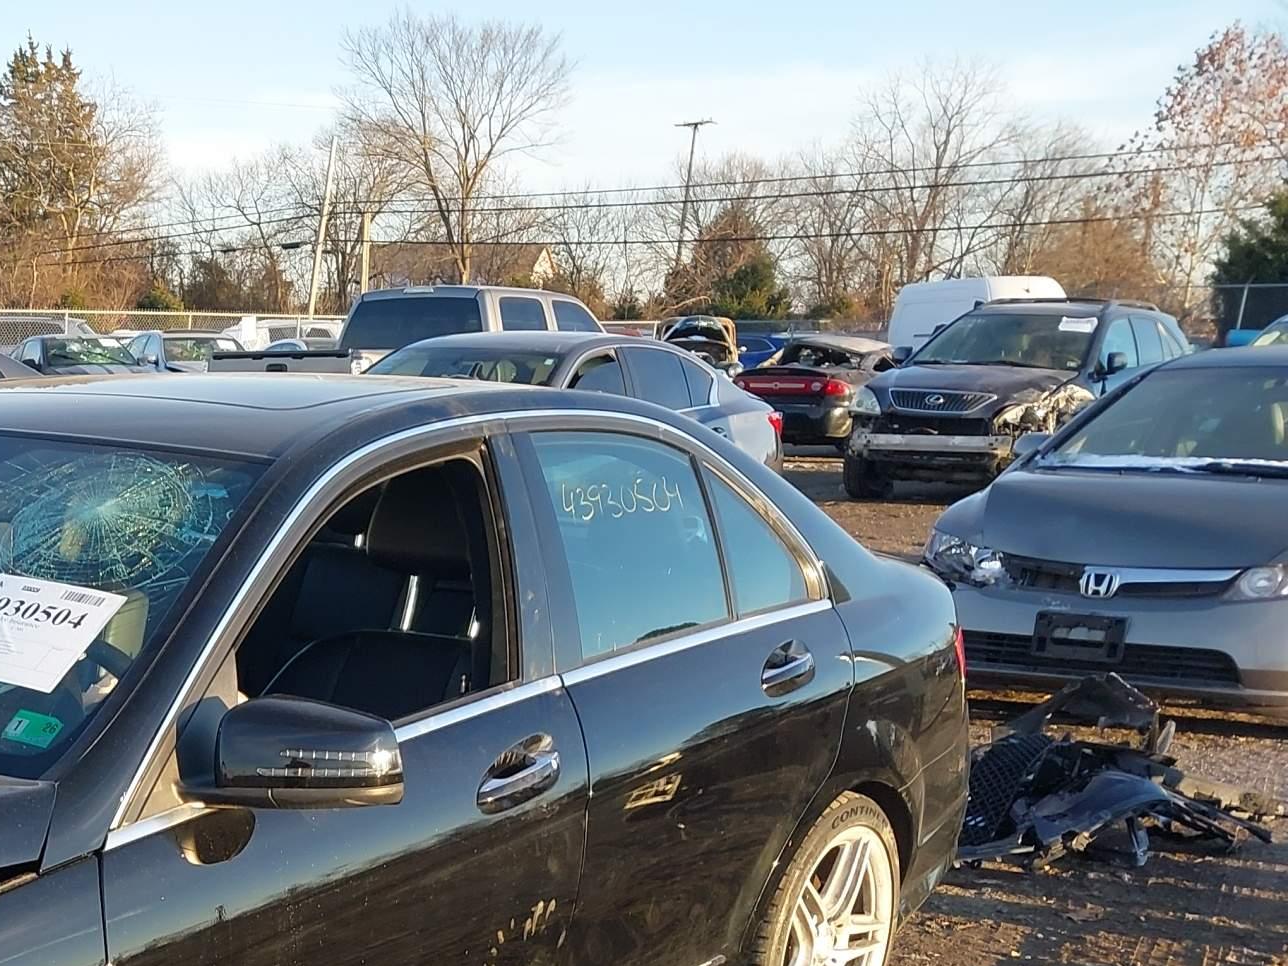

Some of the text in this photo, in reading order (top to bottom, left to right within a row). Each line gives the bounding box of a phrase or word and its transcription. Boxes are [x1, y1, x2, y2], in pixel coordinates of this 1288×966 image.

[562, 475, 684, 523] 43930504
[13, 719, 59, 735] 1 26
